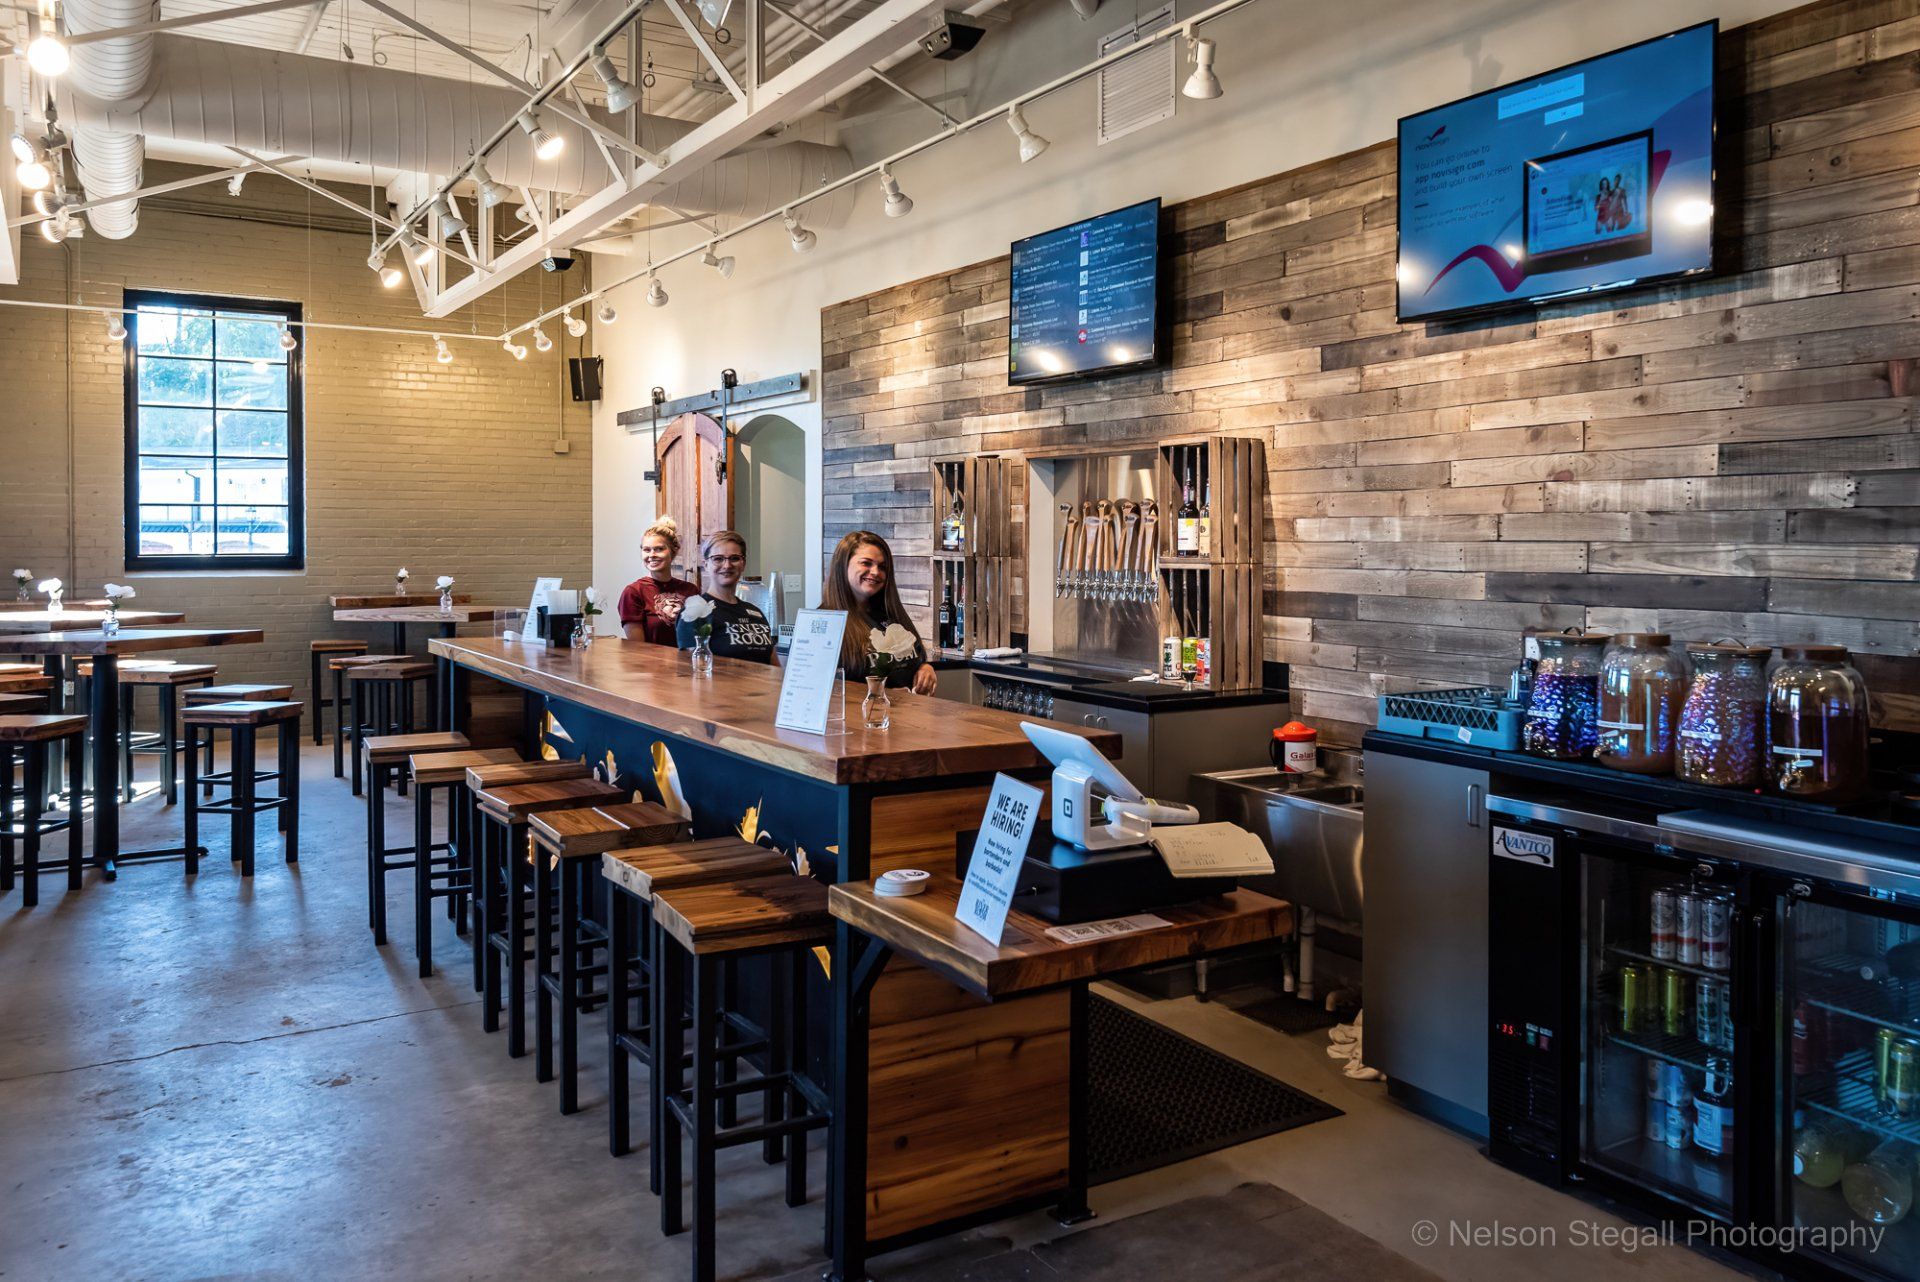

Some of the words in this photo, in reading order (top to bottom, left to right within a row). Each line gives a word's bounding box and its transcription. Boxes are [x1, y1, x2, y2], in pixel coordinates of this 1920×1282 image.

[1481, 145, 1490, 154] to
[1486, 165, 1513, 177] screen
[997, 793, 1011, 812] WE
[1010, 800, 1028, 821] ARE
[990, 810, 1024, 839] HIRING!
[995, 842, 1006, 855] hiring
[1496, 830, 1551, 861] AVANTCO
[1002, 857, 1011, 867] and
